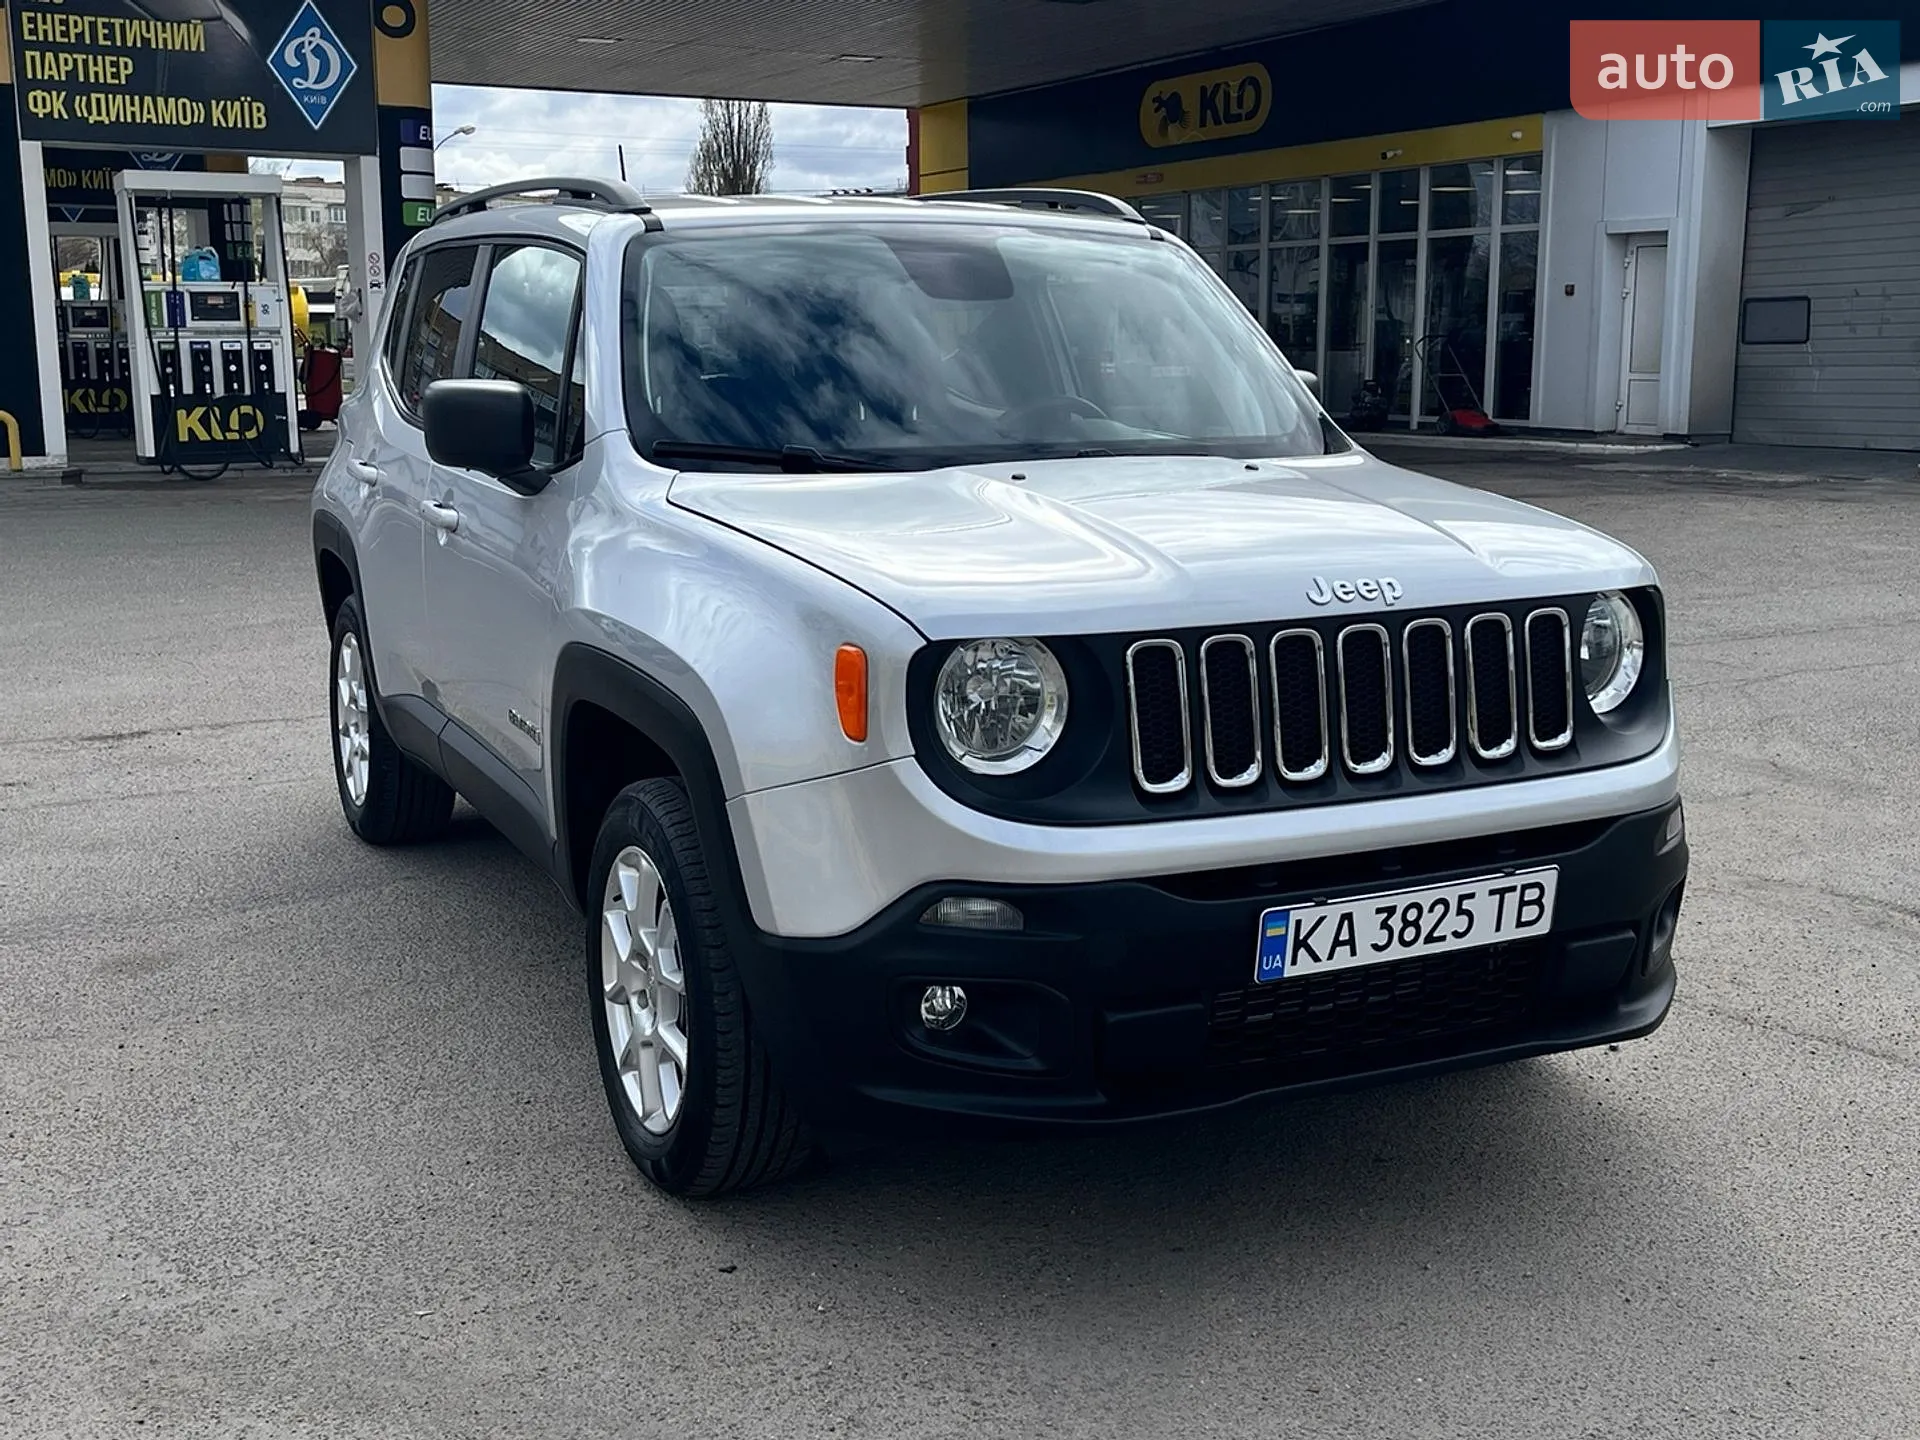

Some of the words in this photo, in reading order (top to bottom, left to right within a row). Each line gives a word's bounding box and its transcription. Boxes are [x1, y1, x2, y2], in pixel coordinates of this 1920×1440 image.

[21, 11, 206, 52] ЕНЕРГЕТИЧНИЙ
[24, 50, 134, 85] ПАРТНЕР
[27, 89, 69, 120] ФК
[74, 92, 206, 126] «ДИНАМО»
[211, 97, 268, 130] КИЇВ
[1198, 75, 1263, 129] KLO
[176, 404, 266, 443] KLO
[1305, 575, 1404, 607] Jeep
[1290, 911, 1358, 967] KA
[1370, 891, 1476, 953] 3825
[1488, 881, 1546, 934] TB
[1262, 954, 1283, 970] UA
